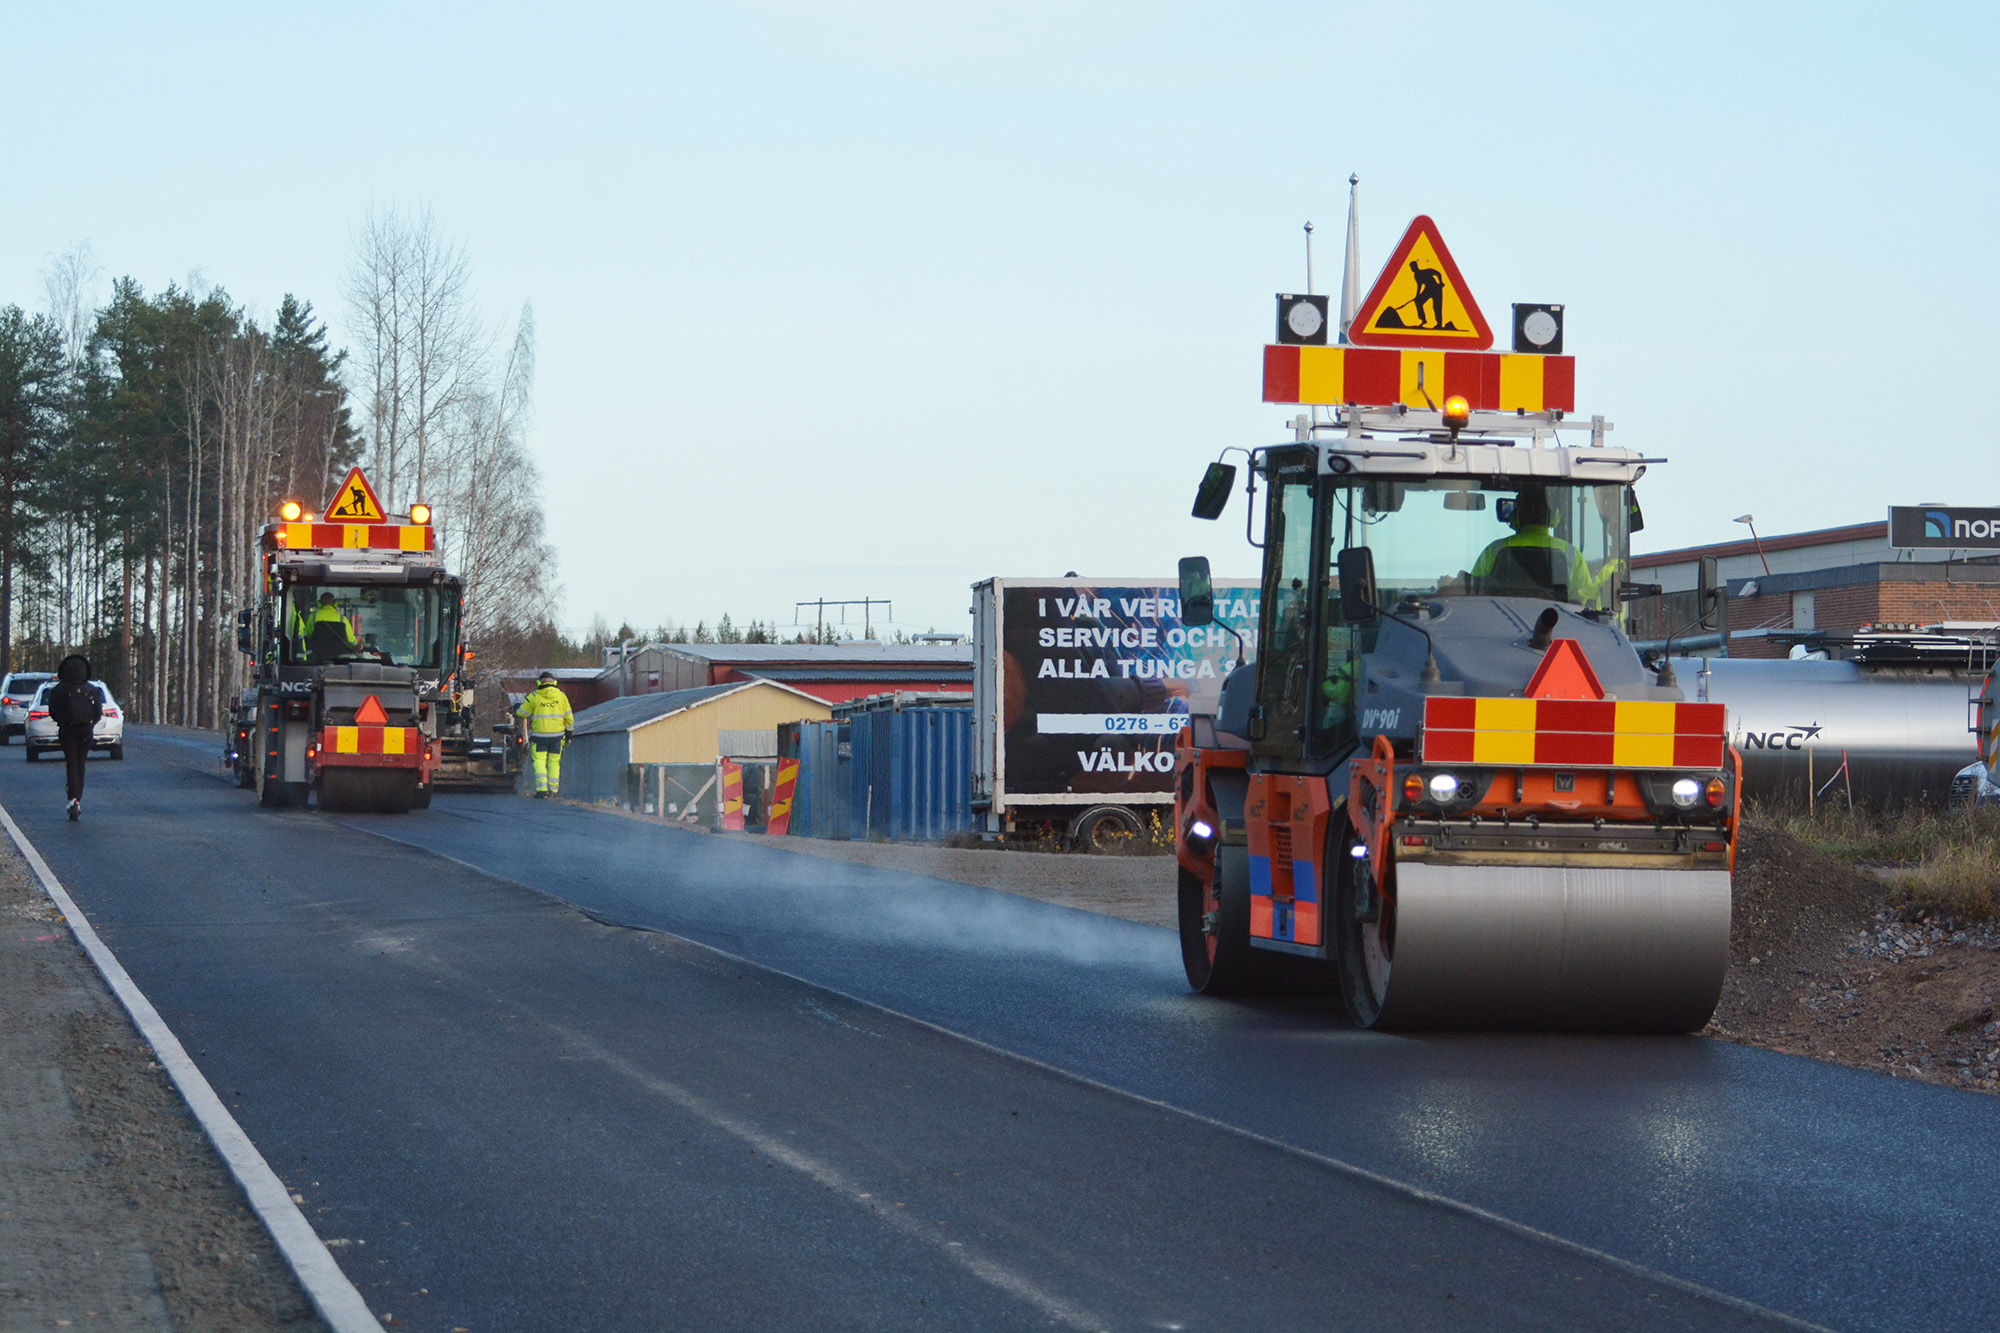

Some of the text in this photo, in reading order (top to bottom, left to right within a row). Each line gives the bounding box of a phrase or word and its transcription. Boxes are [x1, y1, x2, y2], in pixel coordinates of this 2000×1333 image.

[1039, 593, 1260, 618] I VÅR VERTAD
[1039, 627, 1158, 648] SERVICE
[1166, 627, 1226, 648] OCH
[1037, 658, 1110, 678] ALLA
[1117, 658, 1216, 679] TUNGA
[1105, 717, 1148, 731] 0278
[1744, 731, 1803, 750] NCC
[1077, 746, 1175, 773] VÄLKO
